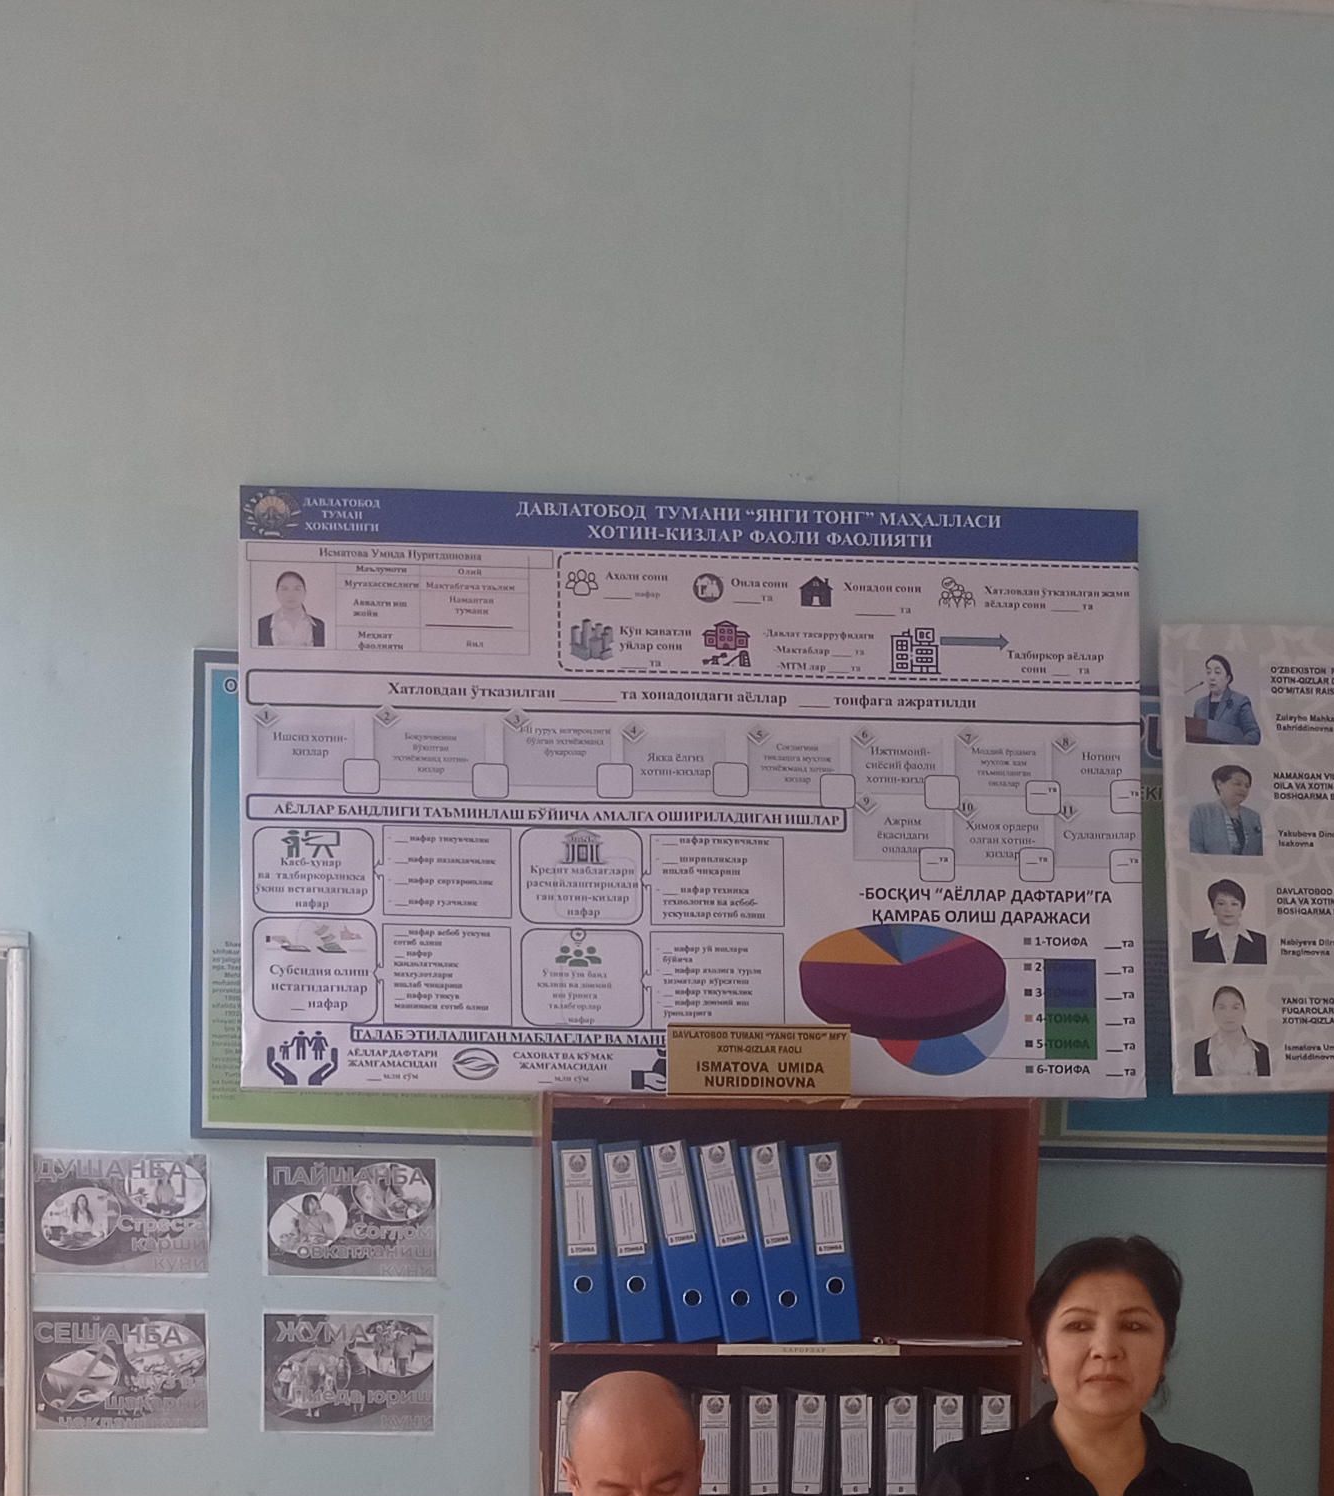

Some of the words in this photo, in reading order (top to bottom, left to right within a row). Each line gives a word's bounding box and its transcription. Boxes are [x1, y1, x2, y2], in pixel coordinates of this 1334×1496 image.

[303, 498, 380, 508] ДАВЛАТОБОД
[322, 511, 362, 520] ТУМАН
[516, 501, 646, 521] ДАВЛАТОБОД
[655, 505, 741, 523] ТУМАНИ
[880, 513, 1001, 530] МАҲАЛЛАСИ
[587, 525, 743, 543] ХОТИН-КИЗЛАР
[749, 529, 819, 546] ФАОЛИ
[826, 531, 933, 548] ФАОЛИЯТИ
[388, 682, 467, 696] Хатловдан
[471, 685, 555, 700] ўтказилган
[621, 691, 637, 700] та
[737, 692, 787, 705] аёллар
[897, 697, 976, 710] ажратилди
[273, 802, 337, 816] АЁЛЛАР
[338, 804, 421, 817] БАНДЛИГИ
[423, 805, 526, 819] ТАЪМИНЛАШ
[593, 810, 655, 823] АМАЛГА
[658, 811, 783, 826] ОШИРИЛАДИГАН
[785, 813, 840, 827] ИШЛАР
[872, 910, 940, 924] ҚАМРАБ
[945, 910, 996, 923] ОЛИШ
[1000, 912, 1090, 926] ДАРАЖАСИ
[1035, 936, 1088, 947] 1-ТОИФА
[269, 965, 331, 979] Субсидия
[353, 1029, 403, 1039] ТАЛАБ
[406, 1029, 507, 1042] ЭТИЛАДИГАН
[606, 1035, 623, 1044] ВА
[697, 1062, 769, 1072] ISMATOVA
[778, 1062, 824, 1073] UMIDA
[1036, 1064, 1090, 1075] 6-ТОИФА
[705, 1076, 815, 1088] NURIDDINOVNA
[273, 1162, 426, 1185] ПАЙШАНБА
[277, 1321, 369, 1342] ЖУМА
[712, 1485, 717, 1493] 4
